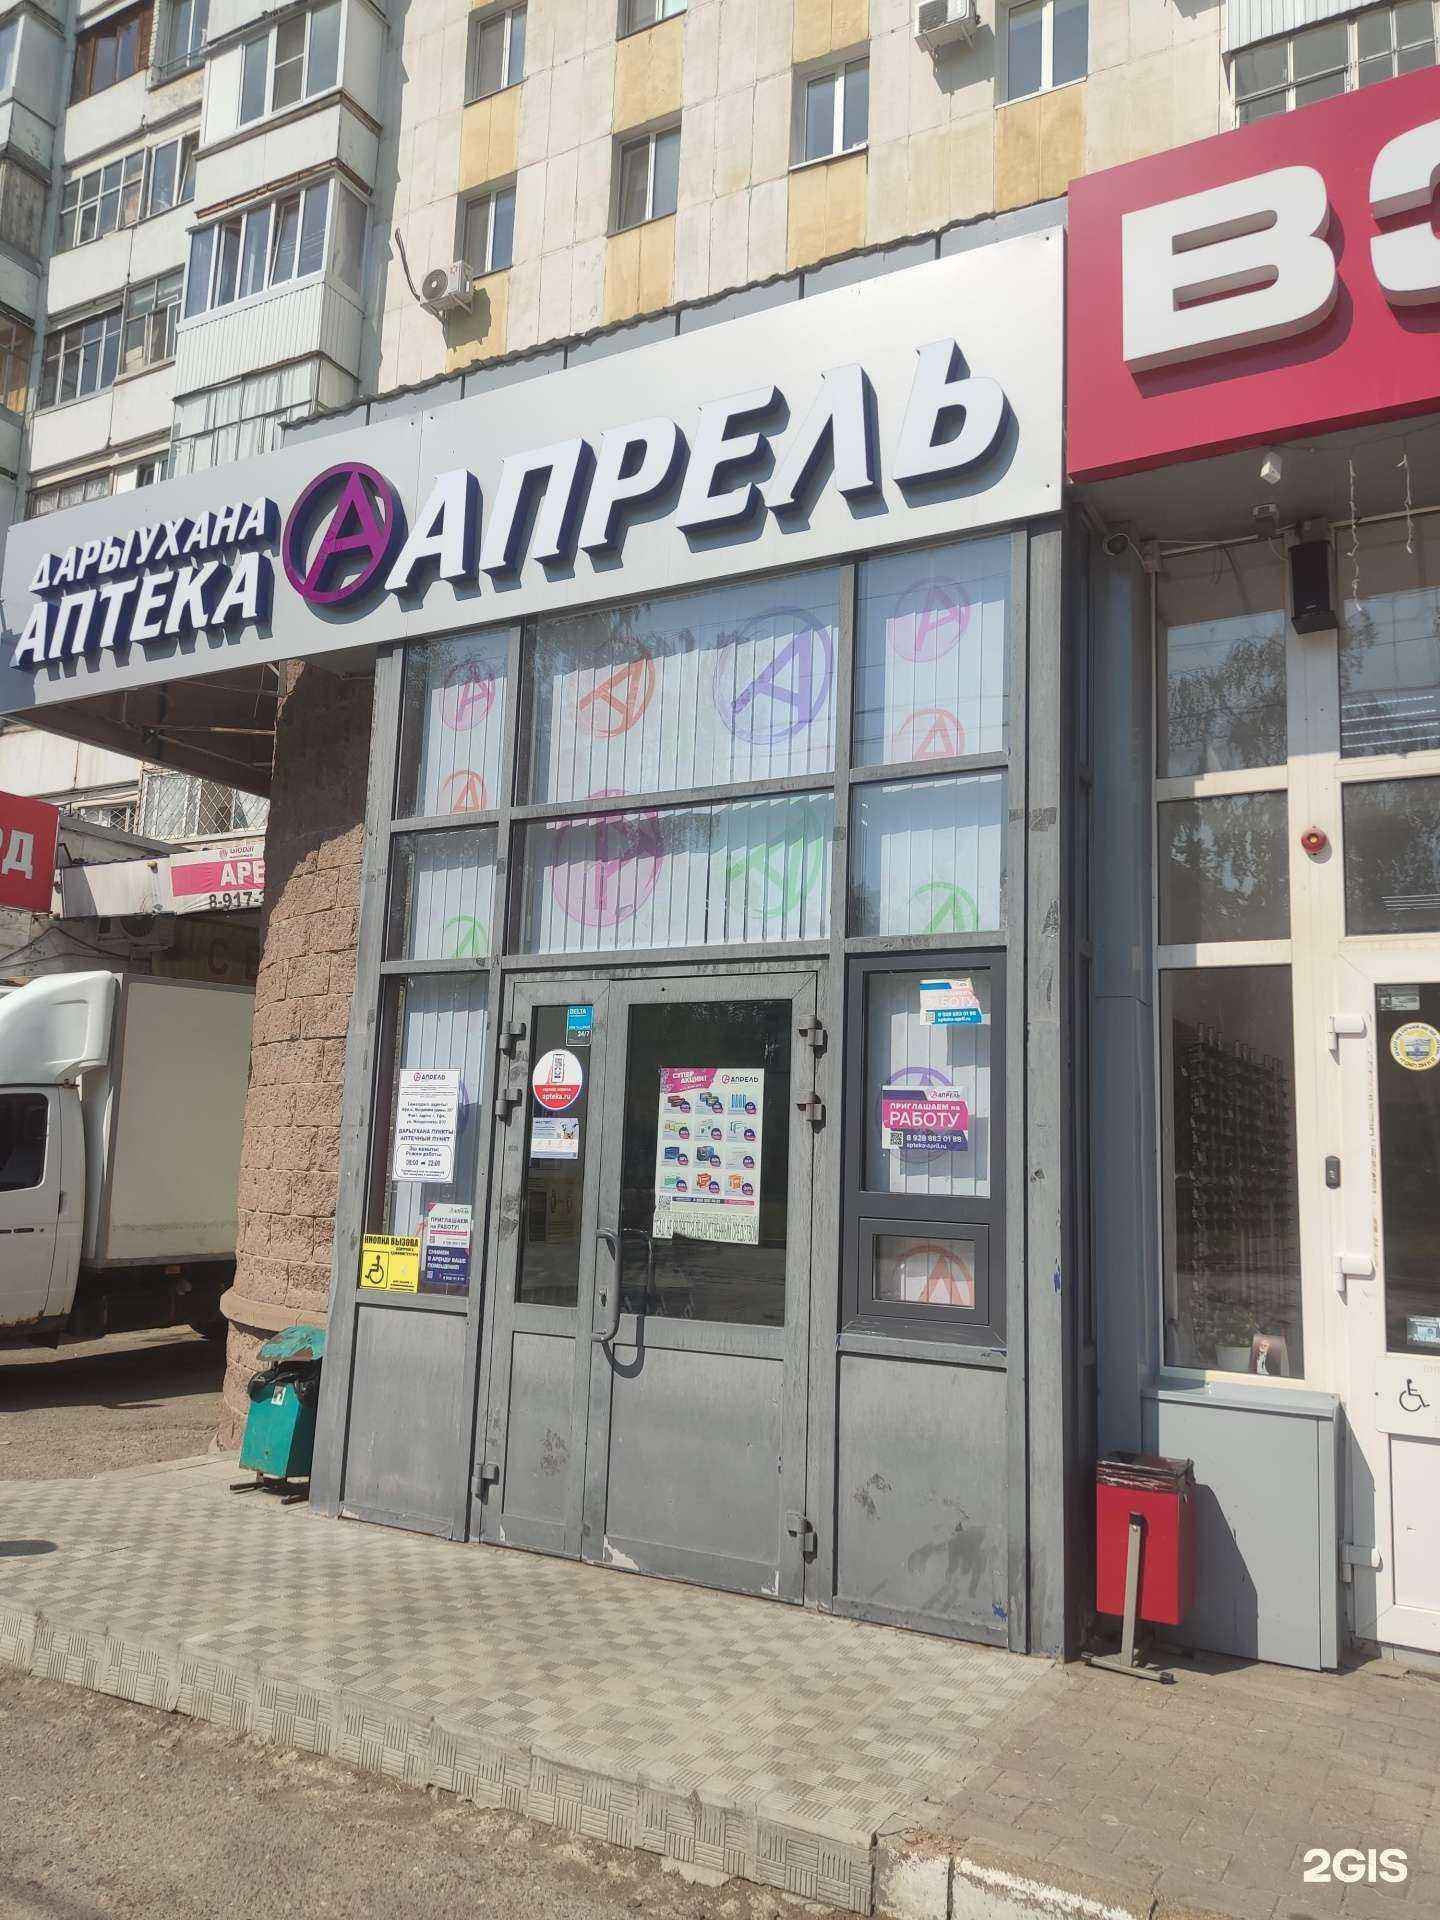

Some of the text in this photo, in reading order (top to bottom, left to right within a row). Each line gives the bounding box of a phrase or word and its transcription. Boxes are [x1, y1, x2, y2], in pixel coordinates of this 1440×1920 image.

[385, 337, 1006, 590] АПРЕЛЬ
[30, 498, 268, 591] ДАРЫУХАНА
[14, 552, 262, 668] АПТЕКА
[0, 828, 34, 880] Д
[542, 1093, 571, 1102] apteka.ru
[890, 1103, 949, 1111] ПРИГЛАШАЕМ
[889, 1112, 961, 1128] РАБОТУ
[364, 1235, 419, 1248] КНОПКА ВЫЗОВА
